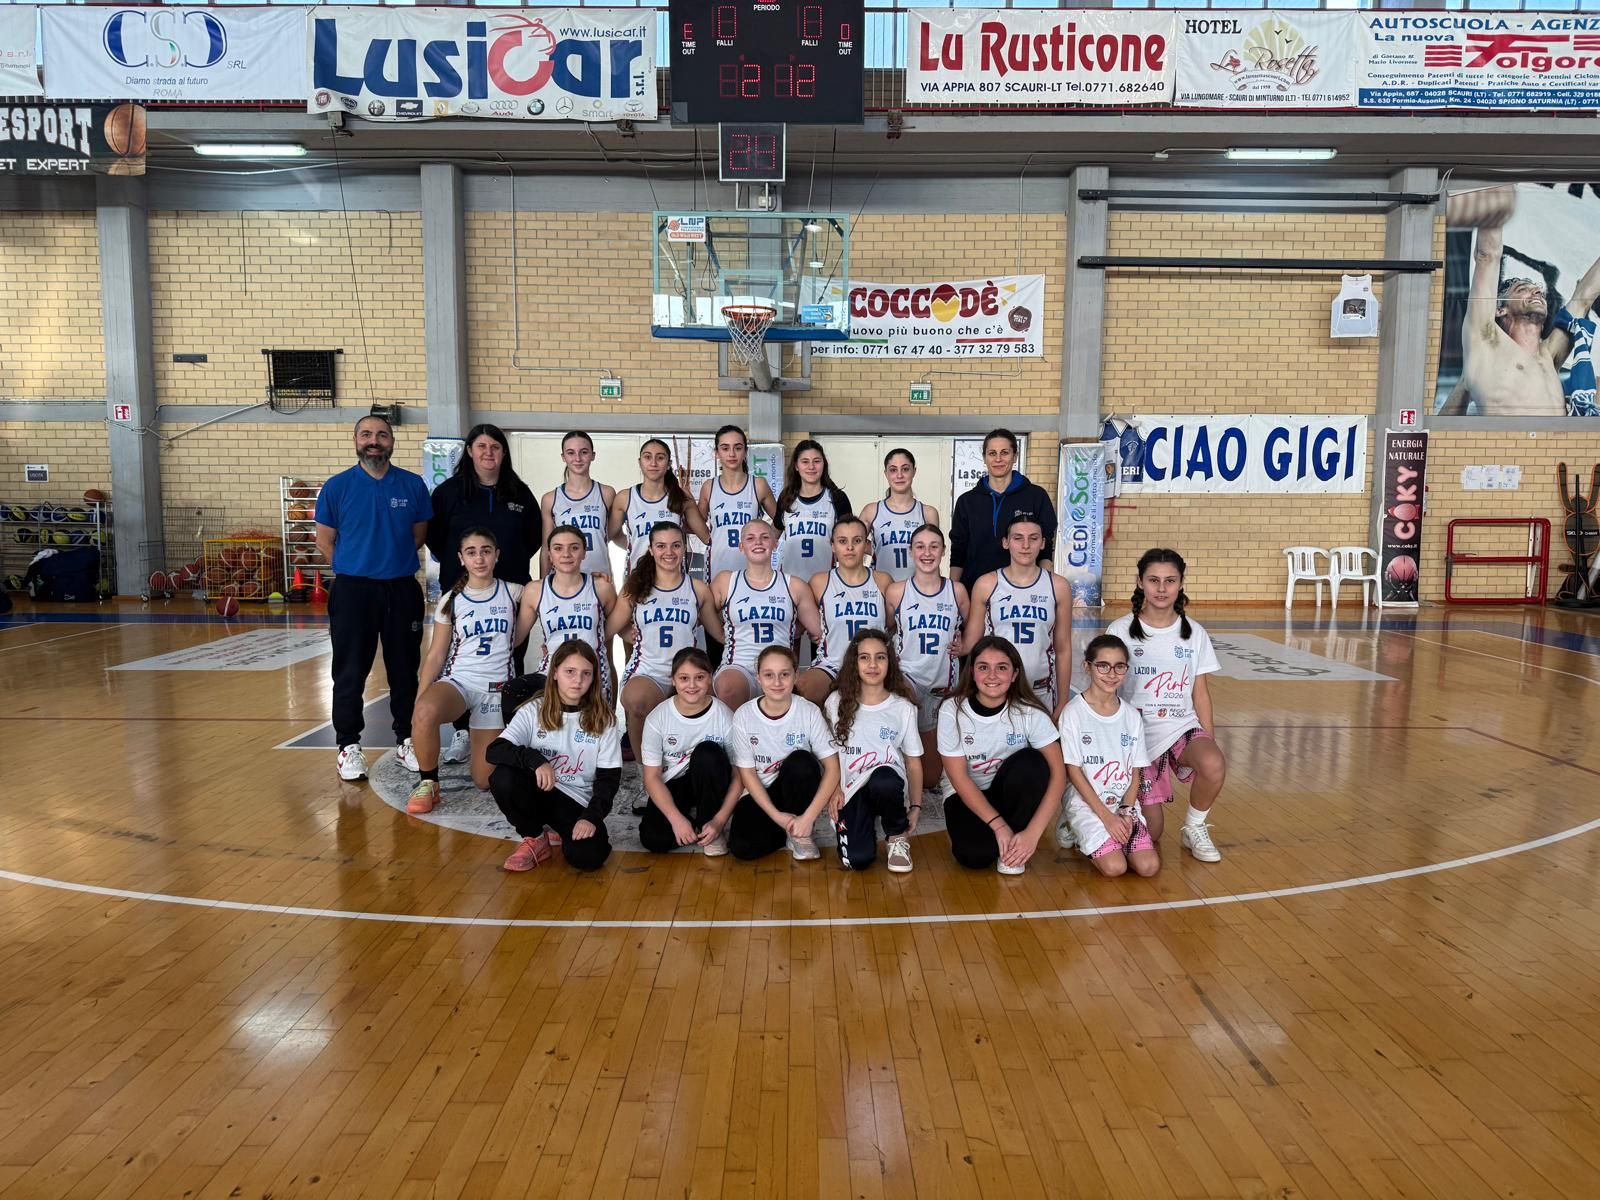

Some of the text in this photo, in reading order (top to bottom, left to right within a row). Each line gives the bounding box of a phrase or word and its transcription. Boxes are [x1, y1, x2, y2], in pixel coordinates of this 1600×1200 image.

[559, 25, 647, 39] www.lusicar.it
[1185, 19, 1243, 34] HOTEL
[1369, 17, 1509, 31] AUTOSCUOLA
[1374, 33, 1395, 41] La
[980, 21, 1166, 78] Rusticone
[226, 59, 247, 69] SRL
[125, 76, 209, 85] Diamo strada al futuro
[635, 71, 645, 96] s.r.l.
[920, 81, 1165, 93] VIA APPIA 807 SCAURI-LT Tel.0771.682640
[1417, 79, 1452, 87] Duplicati
[1454, 79, 1479, 87] Patenti
[153, 88, 183, 97] ROMA
[1191, 93, 1225, 101] LUNGOMARE
[582, 109, 613, 118] smart
[26, 158, 90, 171] EXPERT
[680, 217, 704, 226] LNP
[888, 325, 908, 338] più
[912, 325, 953, 336] buono
[957, 325, 980, 335] che
[810, 343, 1035, 356] per info: 0771 67 47 40 377 32 79 583
[1391, 439, 1423, 448] ENERGIA
[1144, 424, 1358, 482] CIAO GIGI
[1388, 451, 1425, 461] NATURALE
[958, 469, 969, 479] La
[561, 515, 600, 530] AZIO
[715, 511, 752, 527] LAZIO
[789, 521, 827, 537] LAZIO
[727, 529, 740, 547] 8
[880, 530, 912, 547] LAZI
[1068, 525, 1089, 567] CEDI
[801, 538, 814, 558] 9
[893, 548, 908, 568] 11
[643, 607, 691, 625] LAZIO
[738, 605, 786, 623] LAZIO
[835, 601, 878, 618] LAZIO
[1000, 604, 1048, 622] LAZIO
[462, 617, 509, 639] LAZIO
[546, 614, 593, 634] LAZIO
[908, 613, 951, 632] LAZIO
[659, 625, 674, 648] 6
[751, 622, 774, 643] 13
[1011, 622, 1036, 644] 15
[476, 636, 492, 656] 5
[918, 632, 940, 655] 12
[1134, 663, 1190, 698] LAZIO IN Pink
[1082, 755, 1099, 765] LAZIO
[1111, 782, 1128, 791] 202
